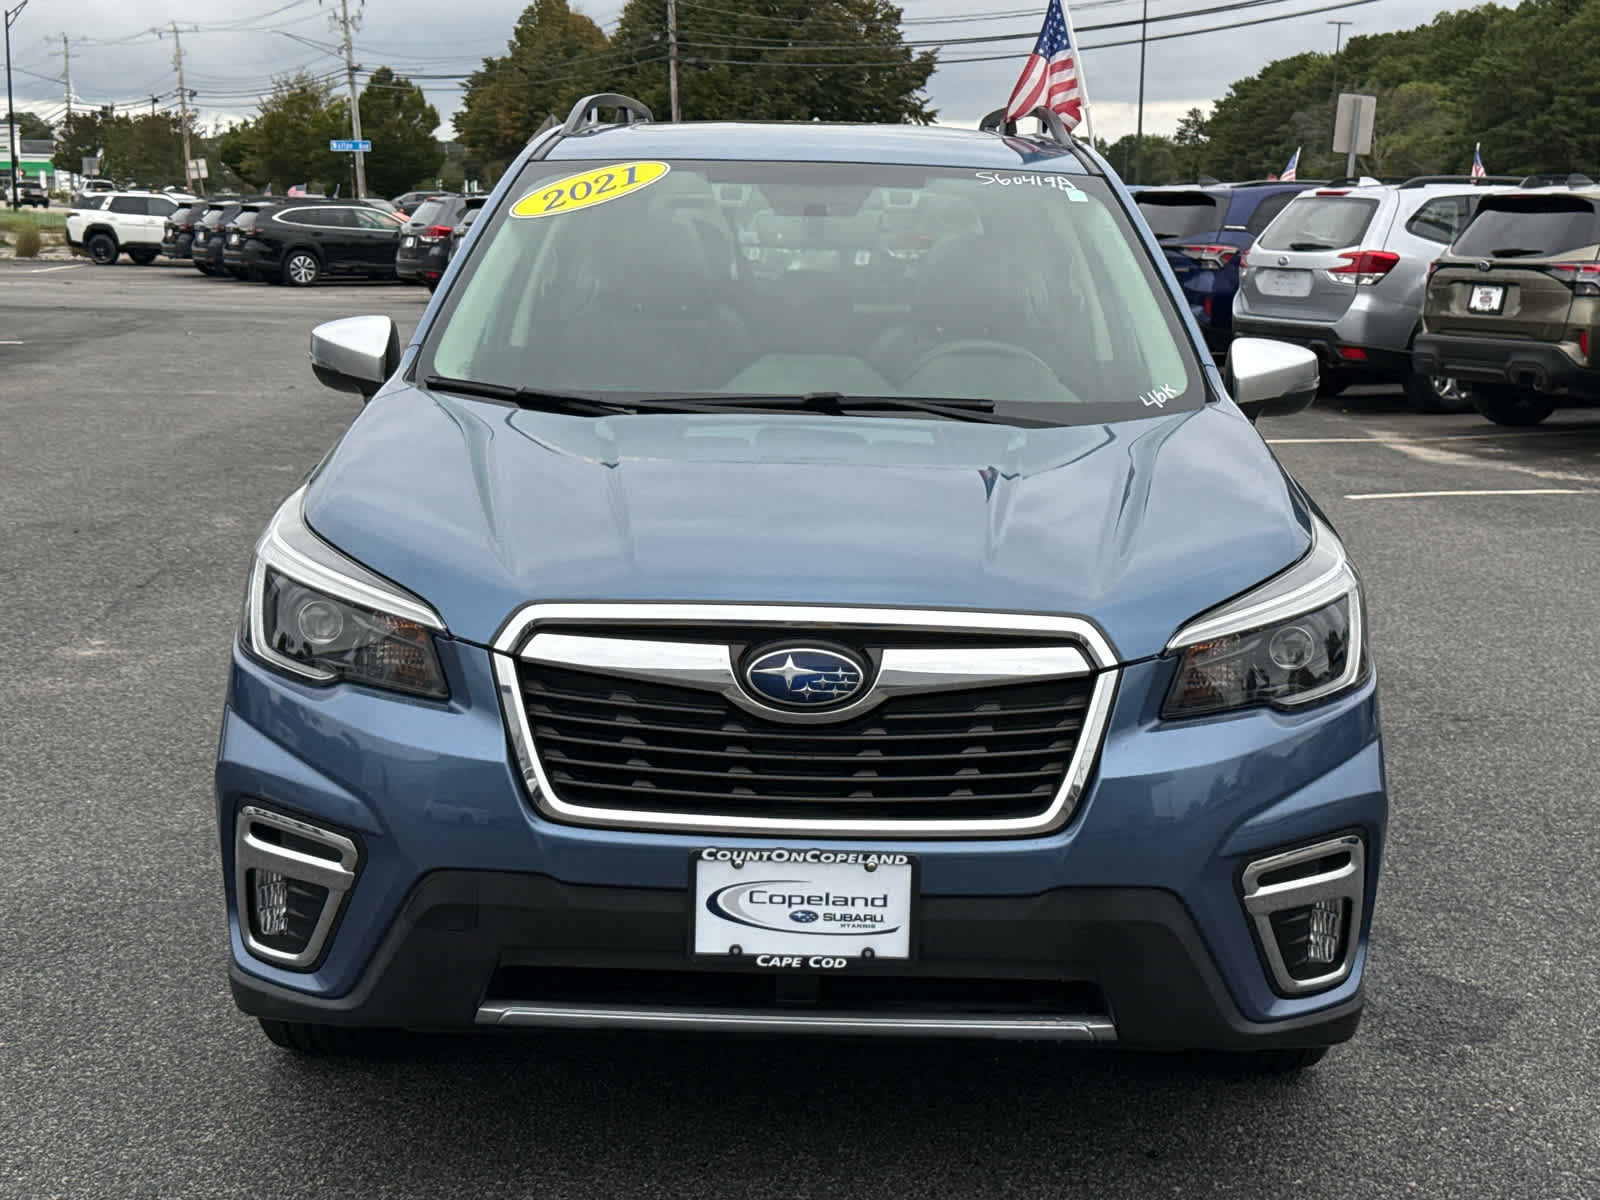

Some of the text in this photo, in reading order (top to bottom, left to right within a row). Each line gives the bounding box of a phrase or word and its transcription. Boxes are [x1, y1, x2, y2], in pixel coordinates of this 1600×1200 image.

[543, 166, 640, 211] 2021
[749, 890, 888, 908] Copeland
[823, 912, 884, 923] SUBARU
[756, 955, 847, 969] CAPE COD
